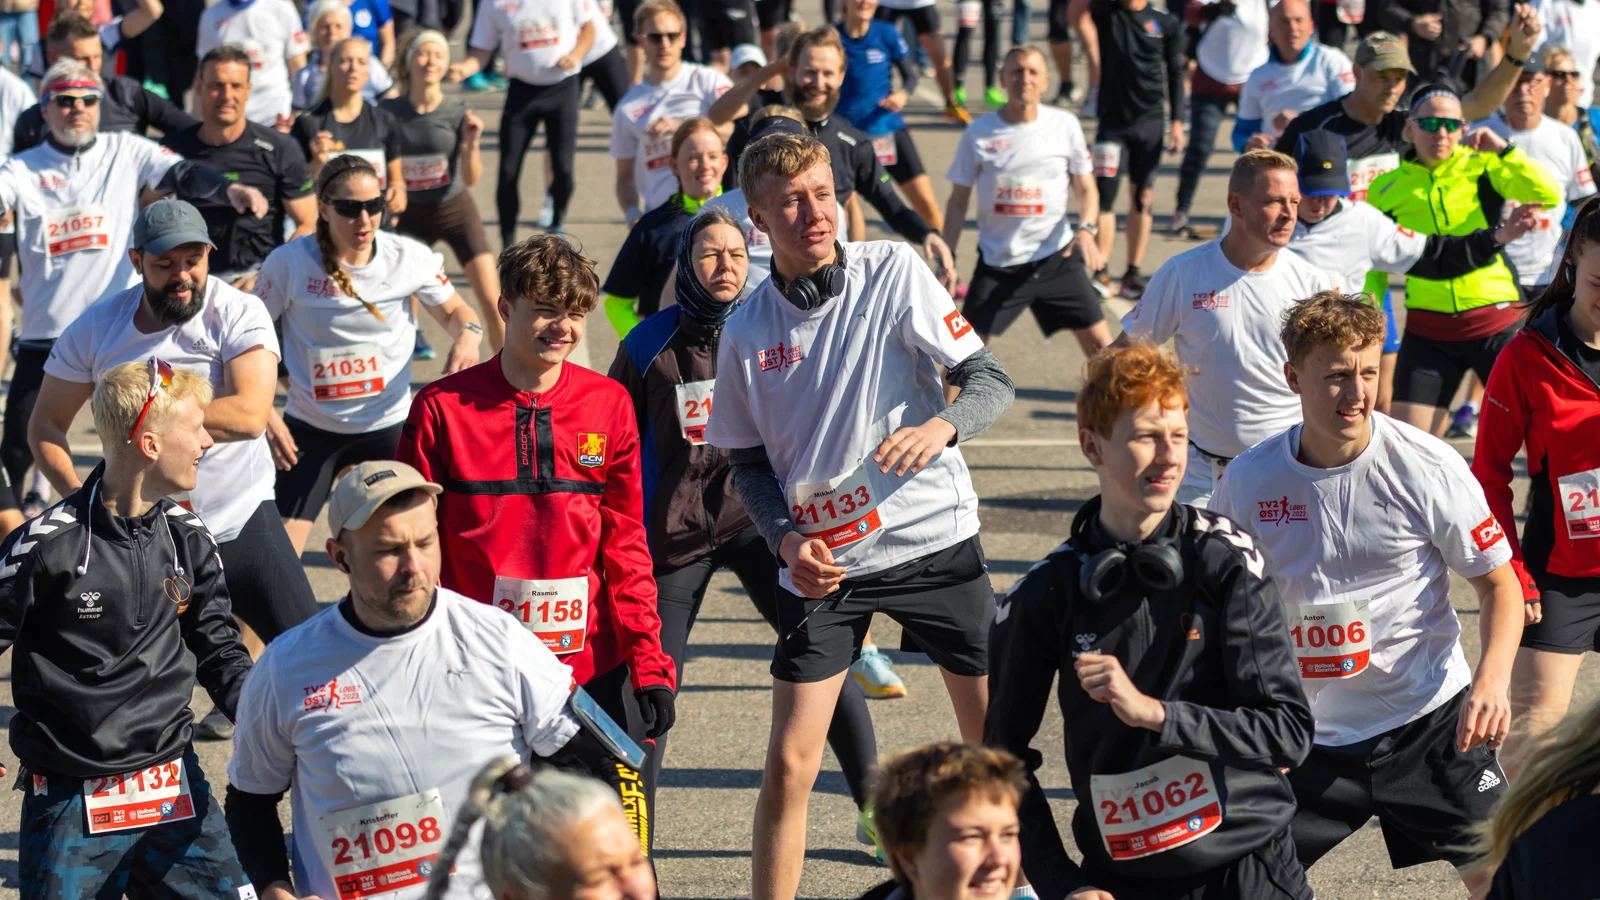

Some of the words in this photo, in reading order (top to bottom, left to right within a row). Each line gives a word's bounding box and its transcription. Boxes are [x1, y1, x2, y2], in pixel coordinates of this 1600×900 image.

[996, 188, 1042, 200] 21068
[48, 216, 104, 237] 21057
[758, 349, 776, 359] TV2
[313, 356, 377, 379] 21031
[760, 357, 778, 368] ØST
[813, 489, 836, 498] Mikkel
[792, 485, 870, 525] 21133
[1258, 500, 1279, 508] TV2
[1259, 510, 1279, 518] ØST
[833, 529, 852, 538] Holbæk
[834, 532, 857, 542] Kommune
[304, 684, 326, 696] TV2
[340, 685, 361, 693] LØBET
[304, 694, 326, 706] ØST
[90, 763, 182, 798] 21132
[1134, 776, 1160, 789] Jacob
[1478, 777, 1501, 792] adidas
[1100, 772, 1209, 825] 21062
[94, 815, 109, 823] DGI
[360, 812, 399, 826] Kristoffer
[331, 816, 441, 866] 21098
[1159, 829, 1188, 843] Kommune
[388, 873, 418, 884] Kommune
[362, 881, 375, 889] ØST
